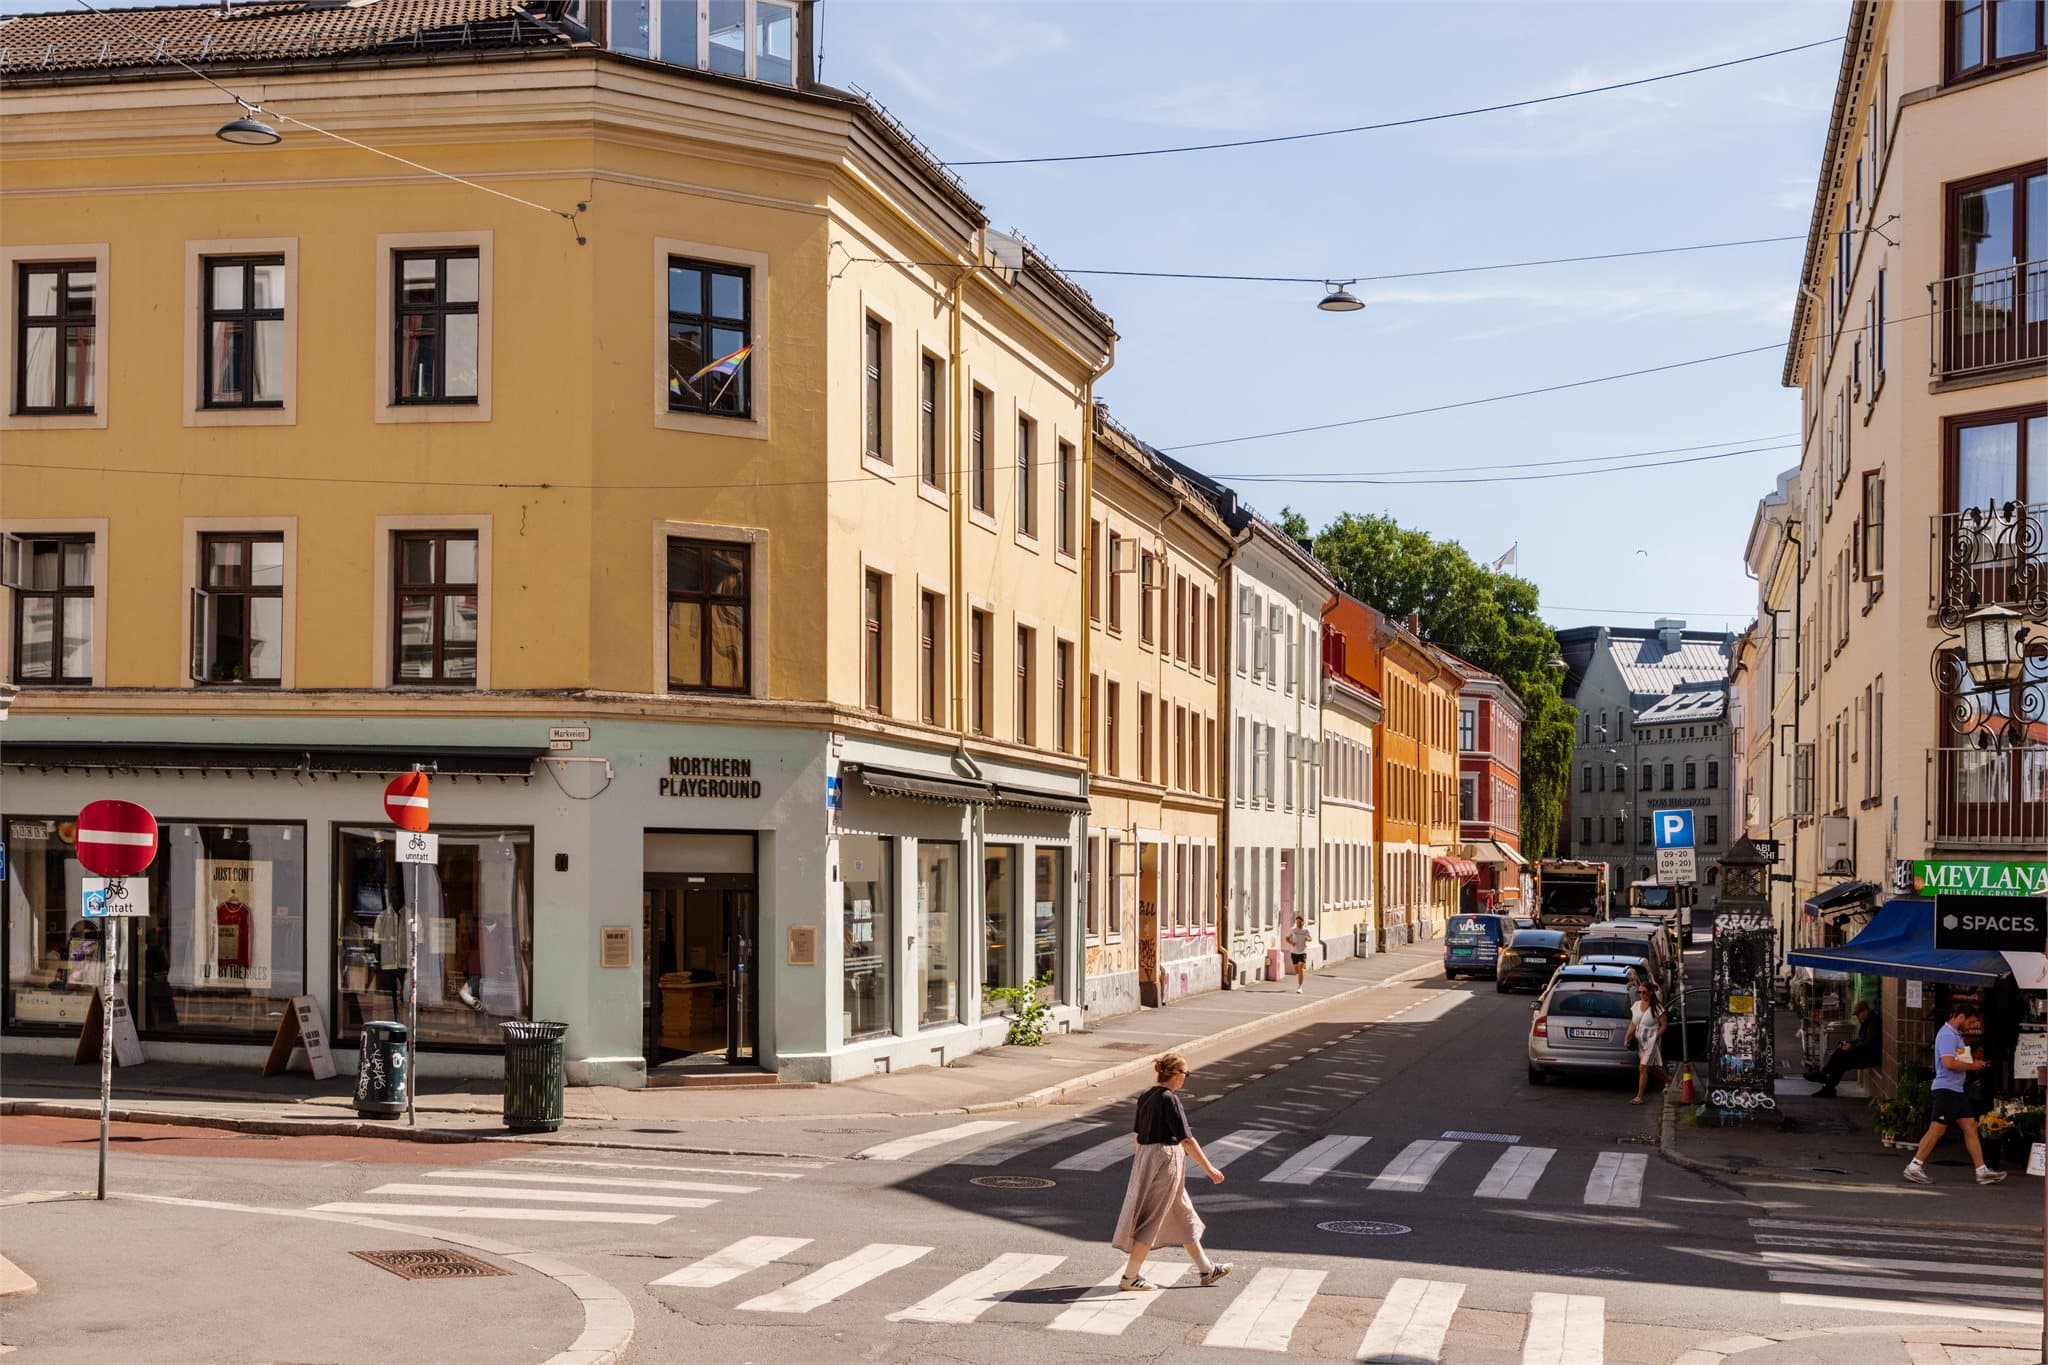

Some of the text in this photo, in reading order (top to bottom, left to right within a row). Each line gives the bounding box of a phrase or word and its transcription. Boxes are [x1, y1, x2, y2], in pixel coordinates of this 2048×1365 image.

[554, 729, 586, 738] Markveien
[669, 757, 751, 777] NORTHERN
[660, 778, 761, 798] PLAYGROUND
[1664, 815, 1684, 844] P
[1755, 843, 1770, 852] ABI
[405, 852, 428, 861] unntatt
[213, 866, 232, 881] JUST
[108, 903, 133, 914] ntatt
[1962, 915, 2039, 932] SPACES.
[218, 965, 228, 978] BY
[229, 965, 243, 979] THE
